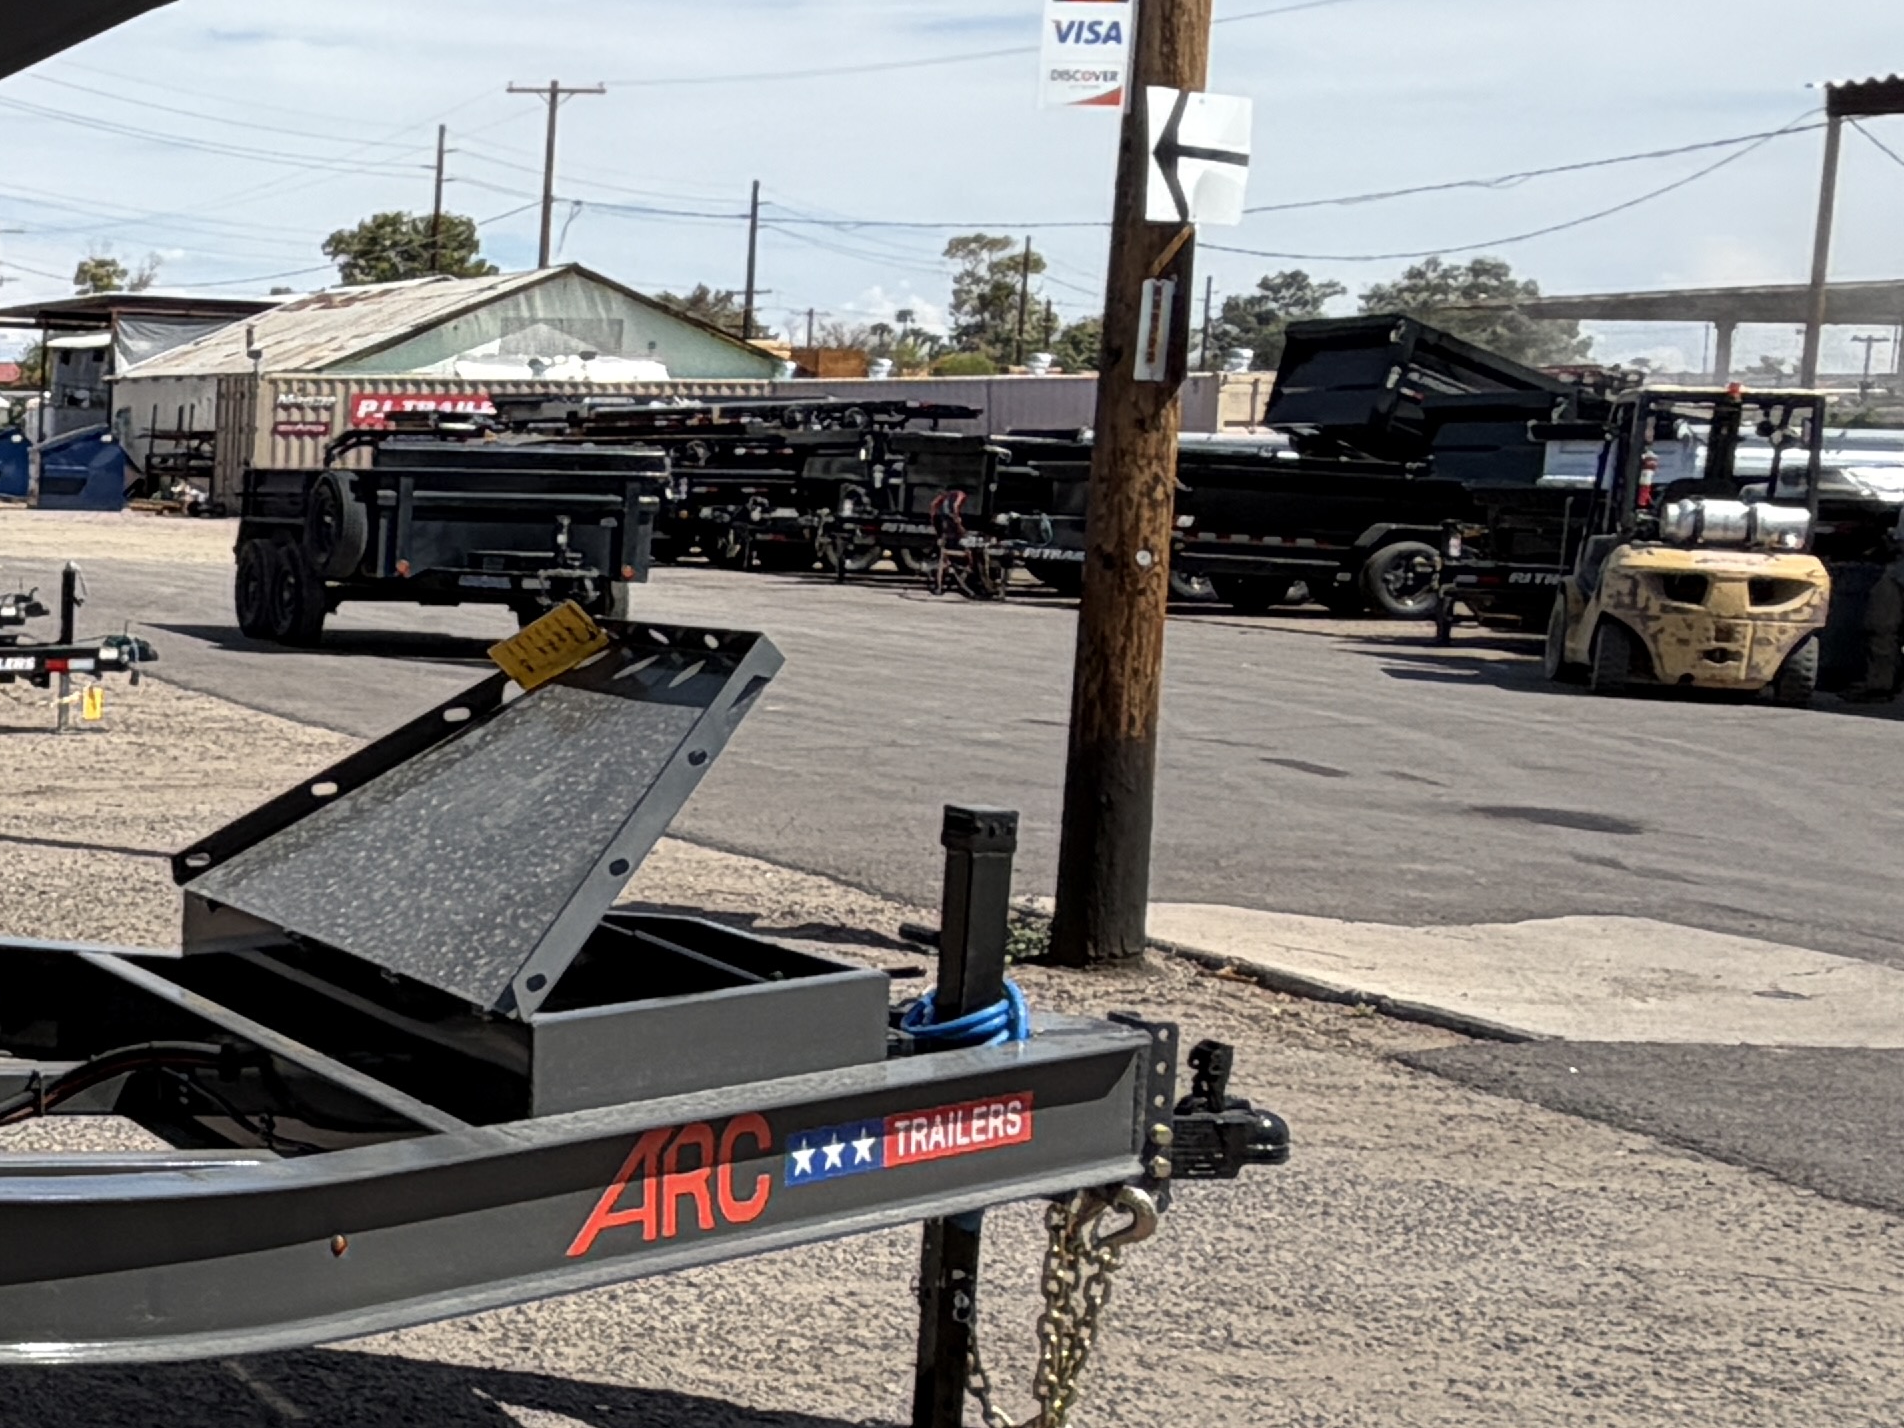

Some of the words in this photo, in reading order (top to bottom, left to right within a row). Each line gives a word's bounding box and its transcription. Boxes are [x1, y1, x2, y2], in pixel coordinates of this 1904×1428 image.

[1050, 19, 1122, 45] VISA
[1050, 69, 1119, 82] DISCOVER
[566, 1110, 773, 1258] ARC
[894, 1096, 1024, 1158] TRAILERS
